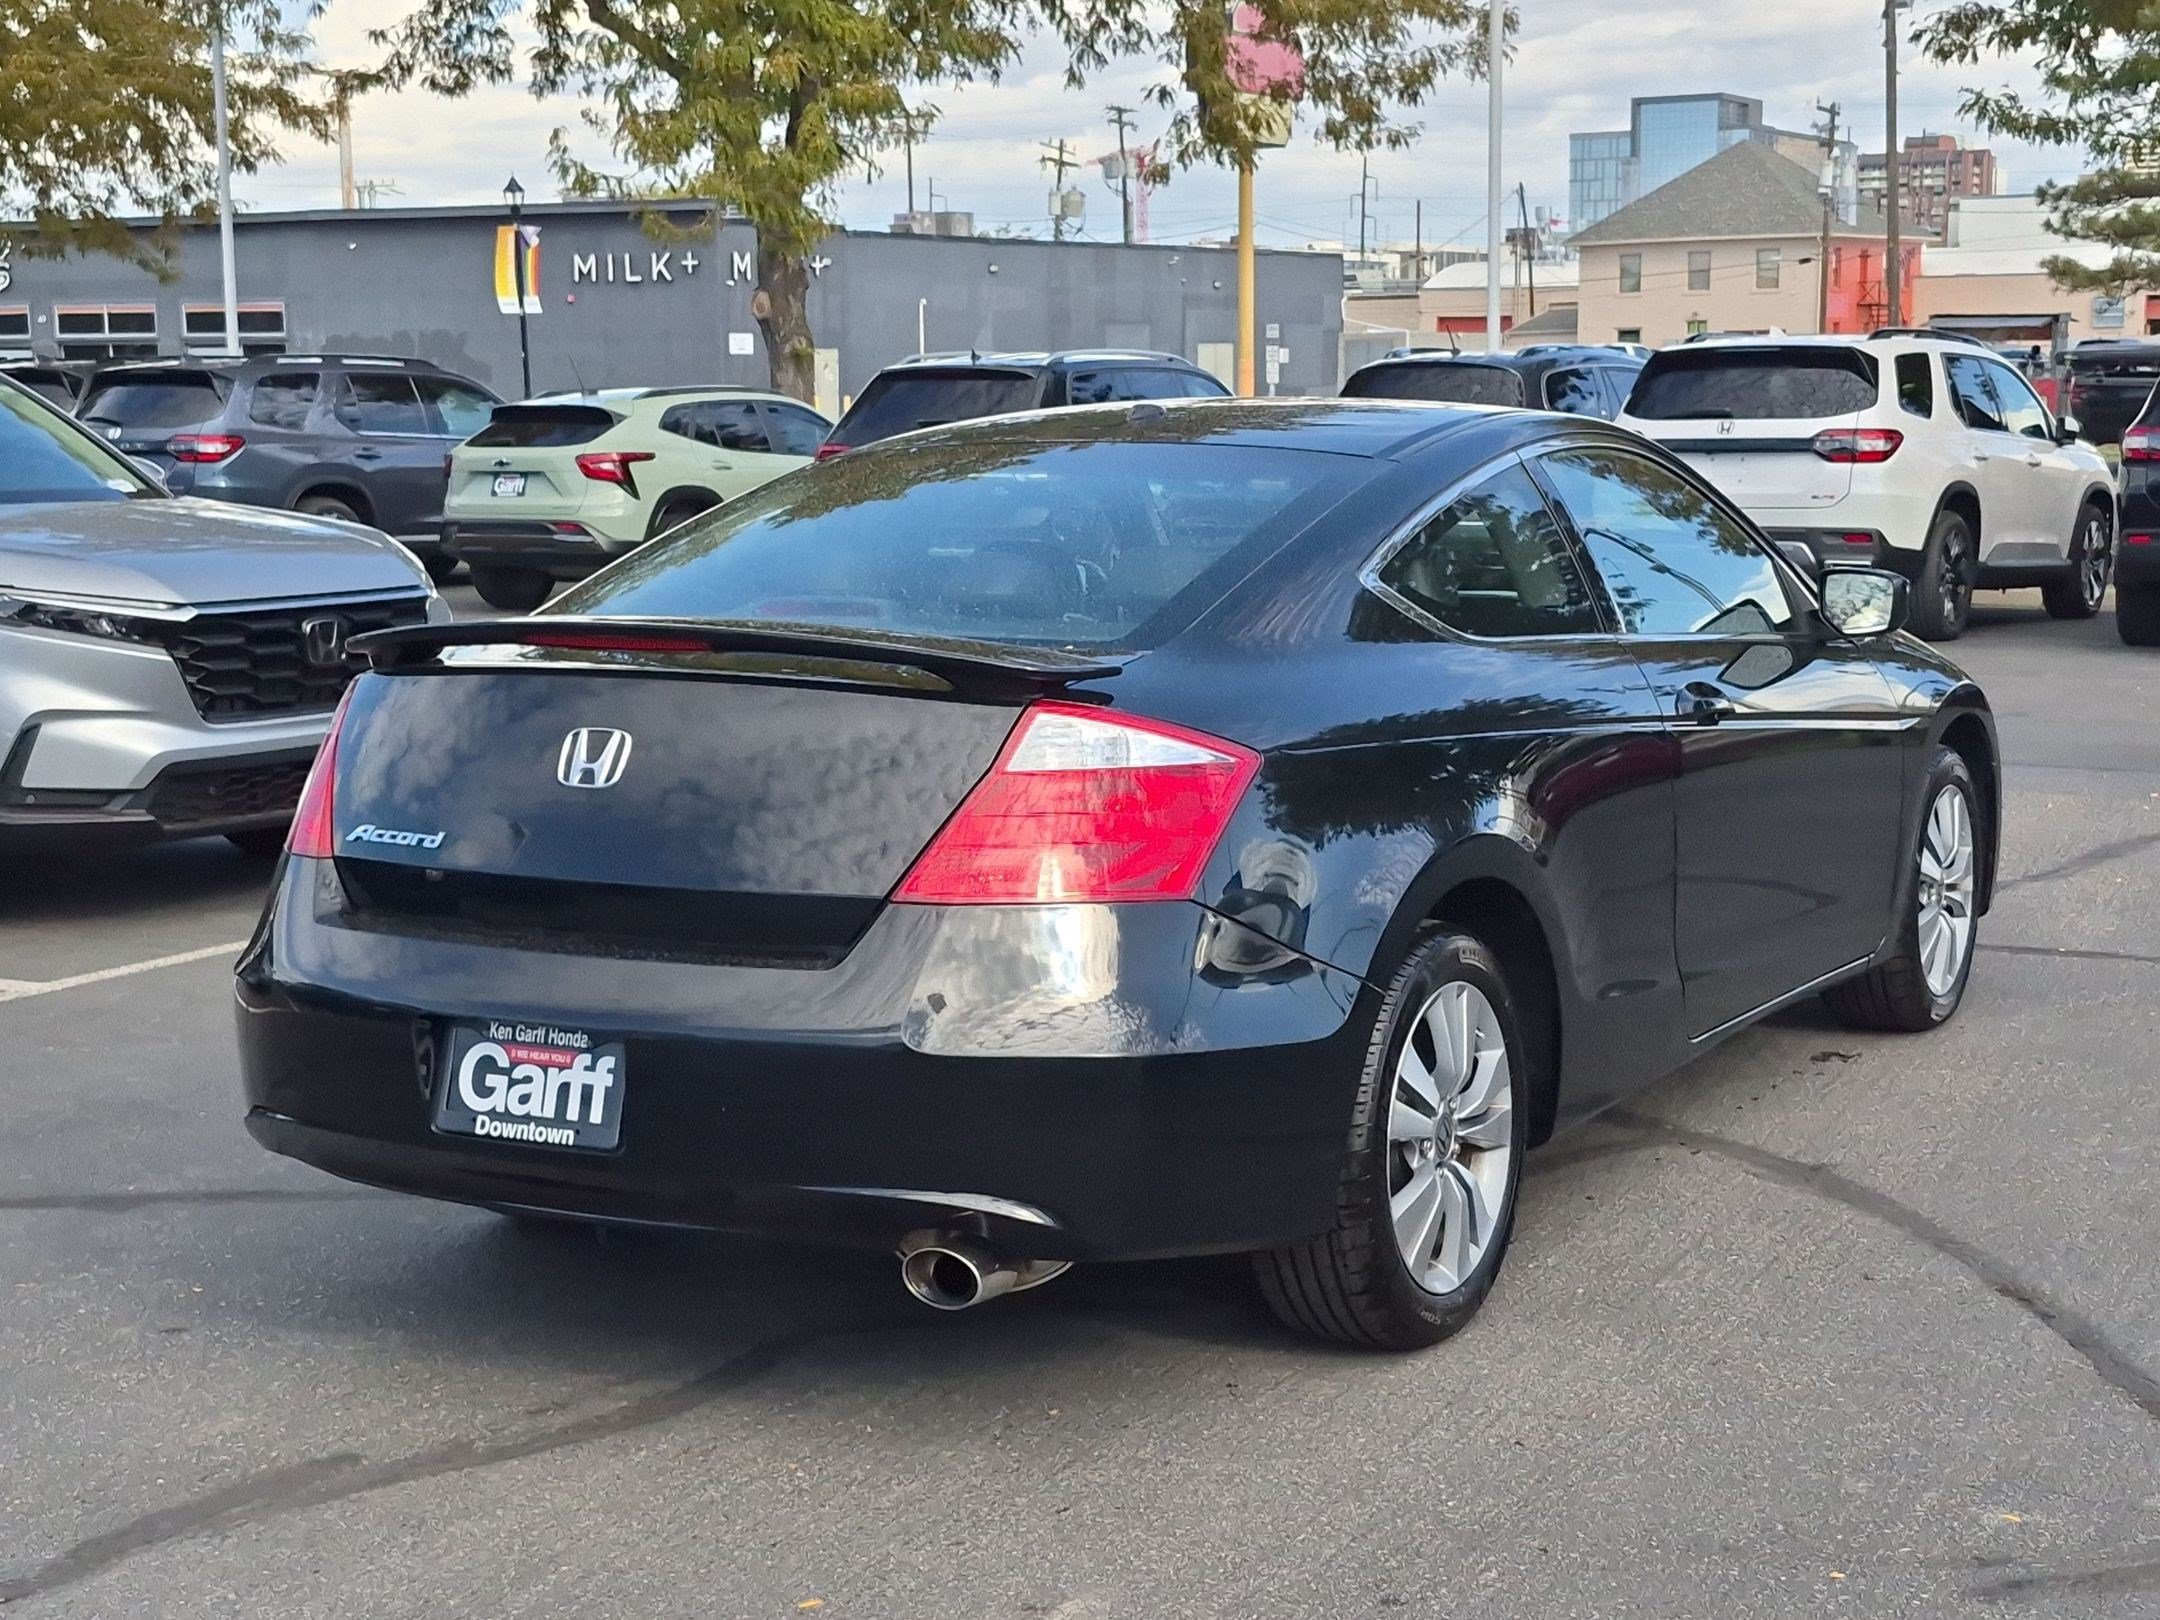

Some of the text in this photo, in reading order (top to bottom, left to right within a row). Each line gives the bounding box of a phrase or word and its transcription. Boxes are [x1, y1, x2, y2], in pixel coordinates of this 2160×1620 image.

[346, 824, 445, 848] Accord
[489, 1021, 589, 1048] Ken Garff Honda
[458, 1041, 616, 1124] Garff
[474, 1114, 575, 1146] Downtown
